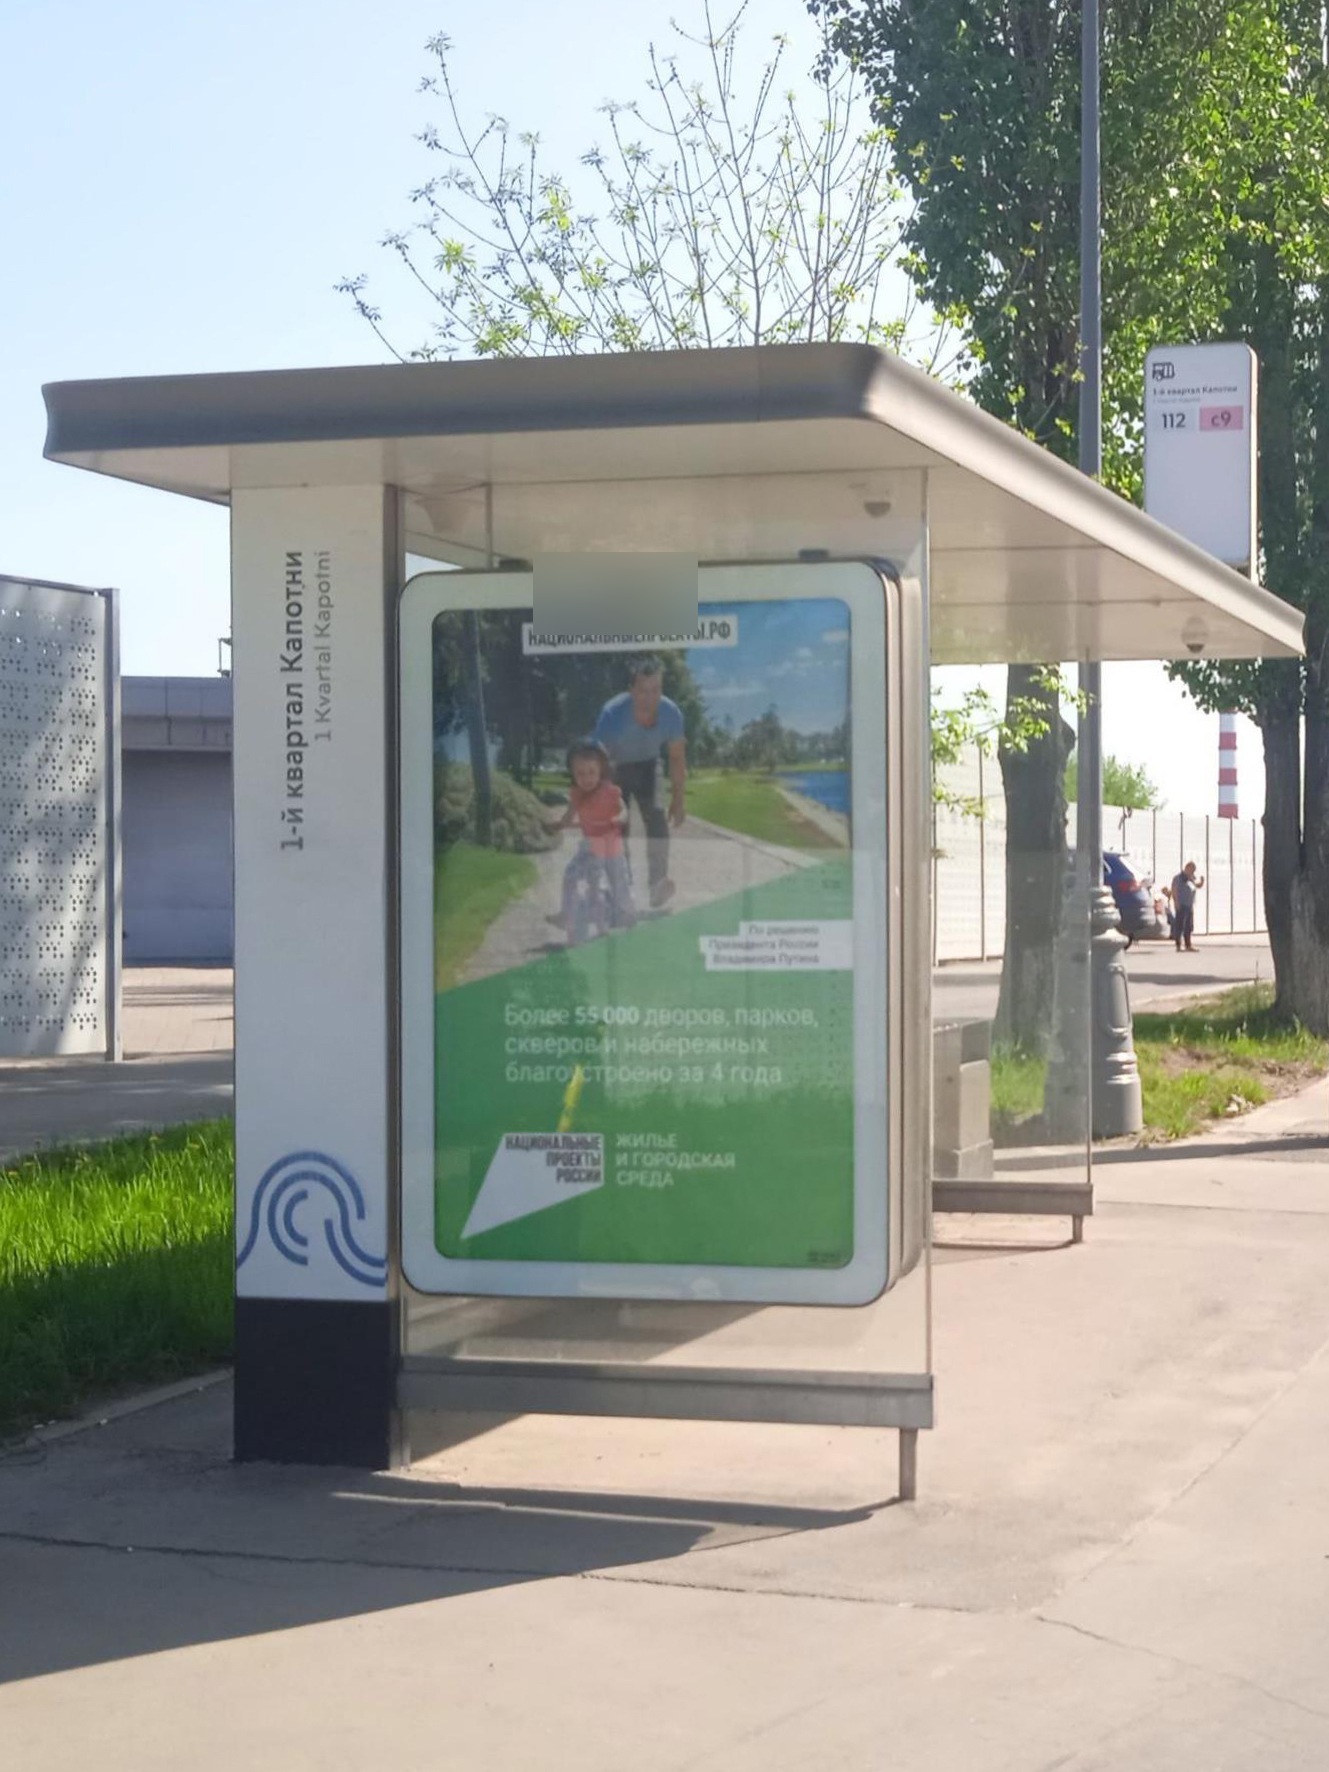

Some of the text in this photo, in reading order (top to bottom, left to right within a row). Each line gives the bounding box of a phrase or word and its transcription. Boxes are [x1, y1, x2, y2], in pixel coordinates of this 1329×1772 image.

[1161, 410, 1232, 429] 112 с9
[314, 550, 335, 742] 1 Kvartal Kapotni
[280, 551, 308, 850] 1-й квартал Капотни
[504, 1003, 570, 1025] Более
[643, 1007, 730, 1029] дворов,
[735, 1007, 820, 1029] парков,
[505, 1032, 769, 1058] скверов и набережных
[678, 1066, 704, 1082] за
[711, 1061, 725, 1081] 4
[731, 1066, 782, 1086] года
[506, 1134, 601, 1151] НАЦИОНАЛЬНЫЕ
[546, 1151, 601, 1167] ПРОЕКТЫ
[616, 1152, 736, 1169] И ГОРОДСКАЯ
[556, 1168, 601, 1184] РОССИИ
[616, 1171, 675, 1188] СРЕДА
